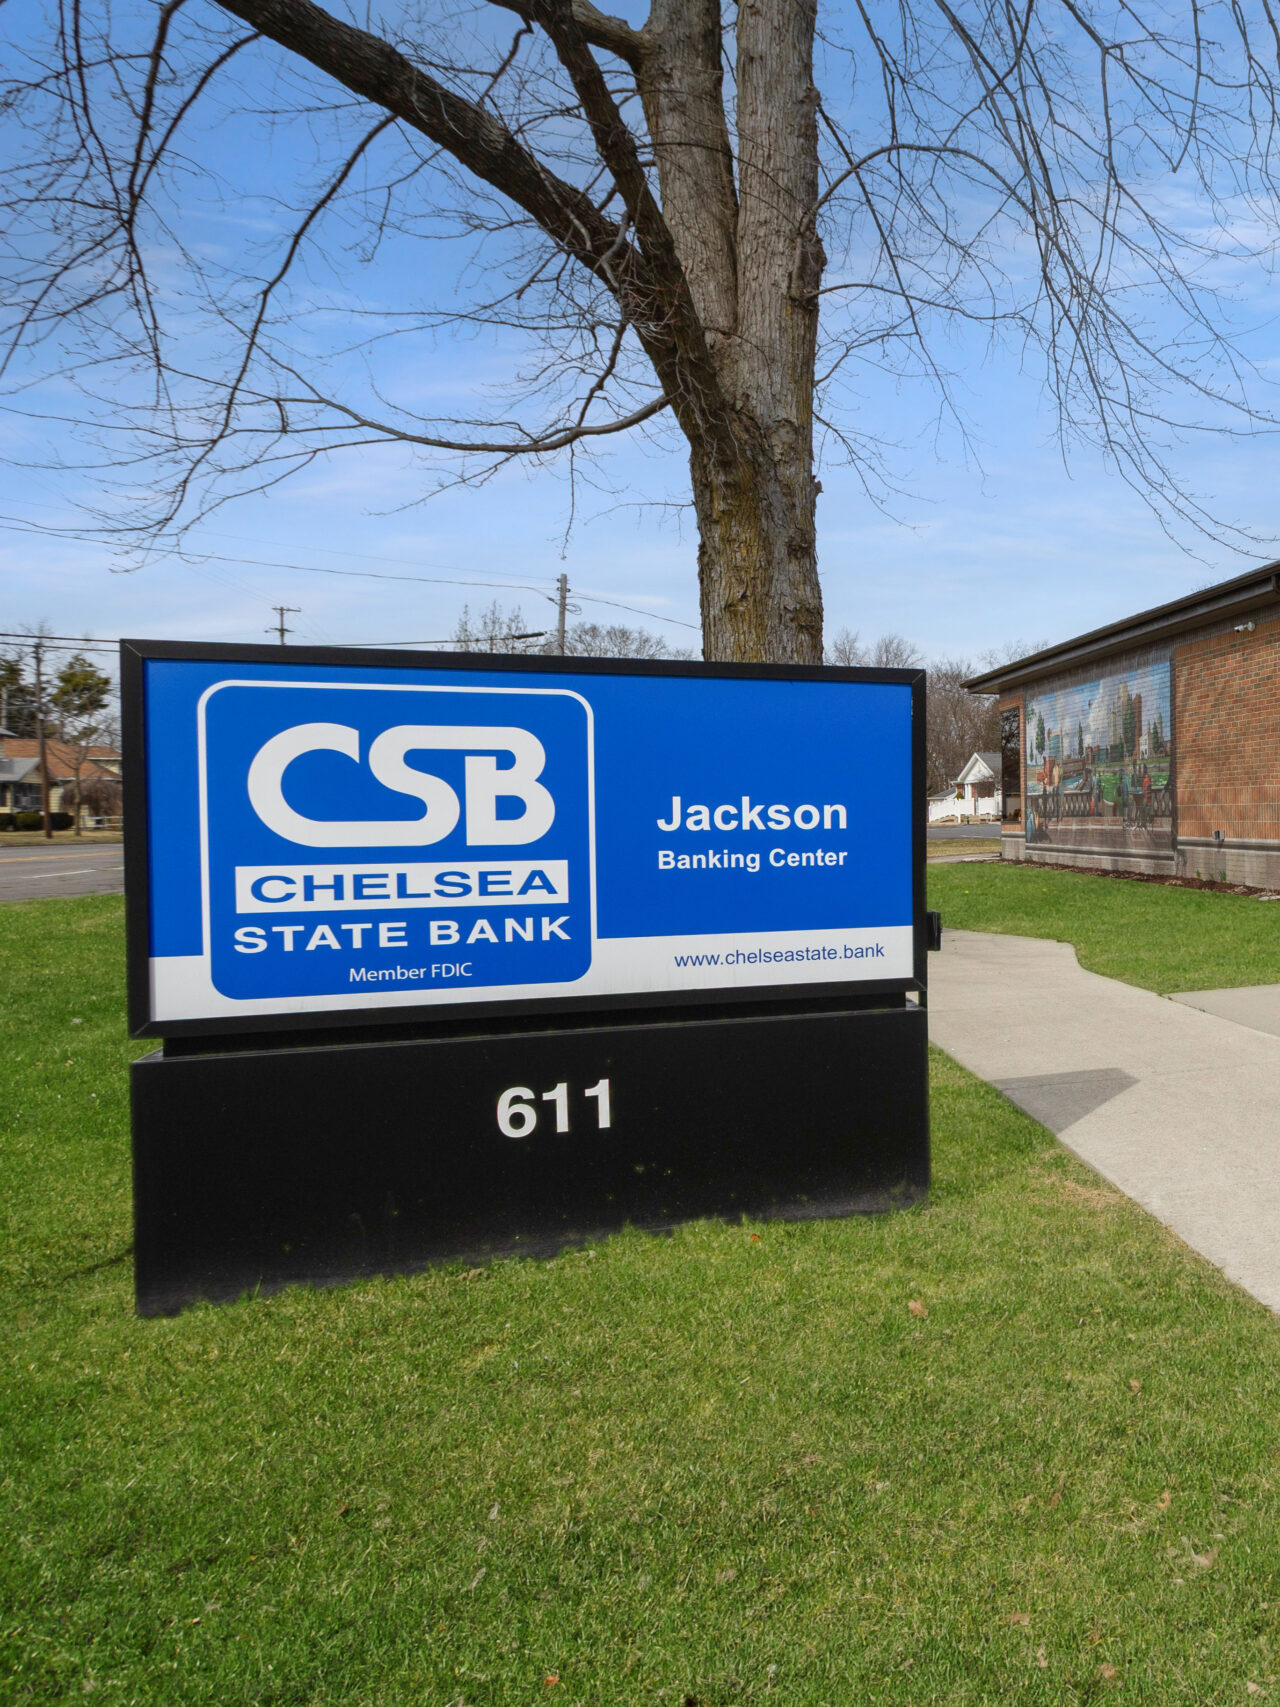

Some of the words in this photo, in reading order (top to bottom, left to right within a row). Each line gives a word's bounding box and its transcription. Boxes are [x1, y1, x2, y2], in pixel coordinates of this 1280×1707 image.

[247, 722, 556, 848] CSB
[656, 795, 848, 832] Jackson
[657, 849, 761, 873] Banking
[768, 847, 848, 867] Center
[250, 869, 557, 904] CHELSEA
[233, 921, 409, 954] STATE
[429, 915, 572, 946] BANK
[348, 965, 427, 982] Member
[431, 962, 473, 979] FDIC
[674, 943, 885, 967] www.chelseastate.bank
[496, 1078, 613, 1139] 611
